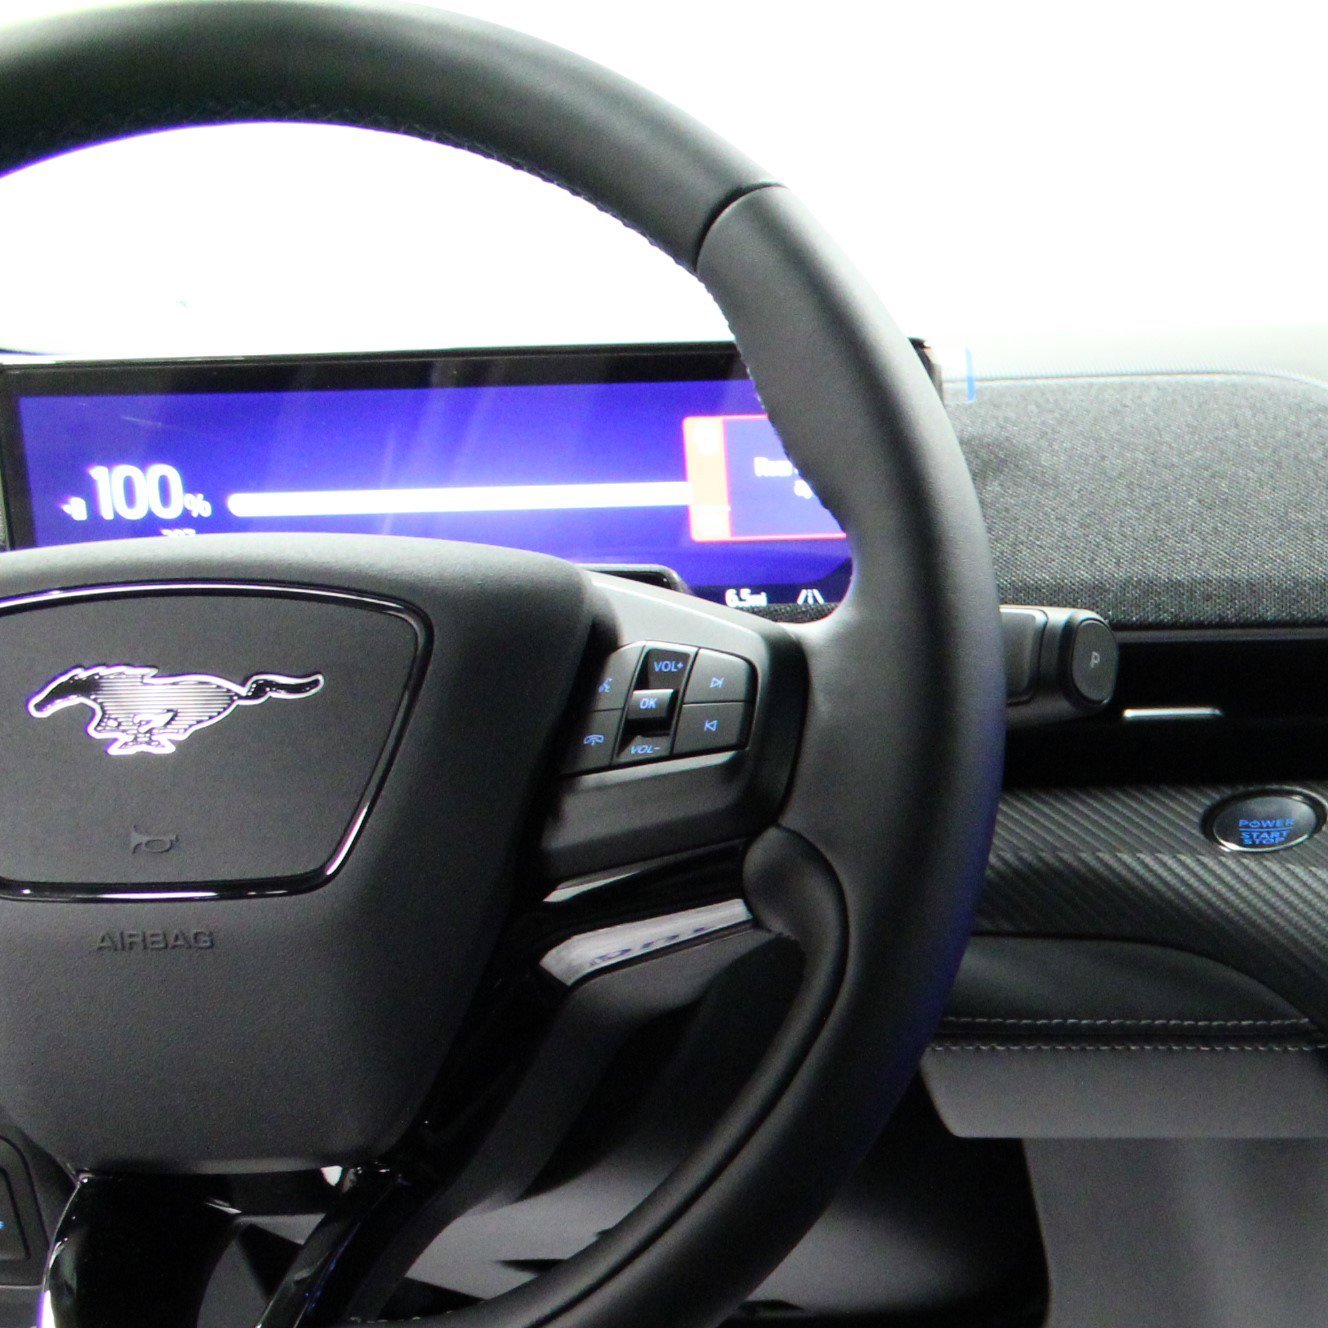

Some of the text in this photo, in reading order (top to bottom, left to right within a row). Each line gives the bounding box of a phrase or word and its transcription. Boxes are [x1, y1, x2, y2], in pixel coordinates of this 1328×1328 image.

[639, 697, 658, 710] OK
[1238, 818, 1295, 828] POWER
[1240, 831, 1290, 839] START
[96, 929, 215, 951] AIRBAG
